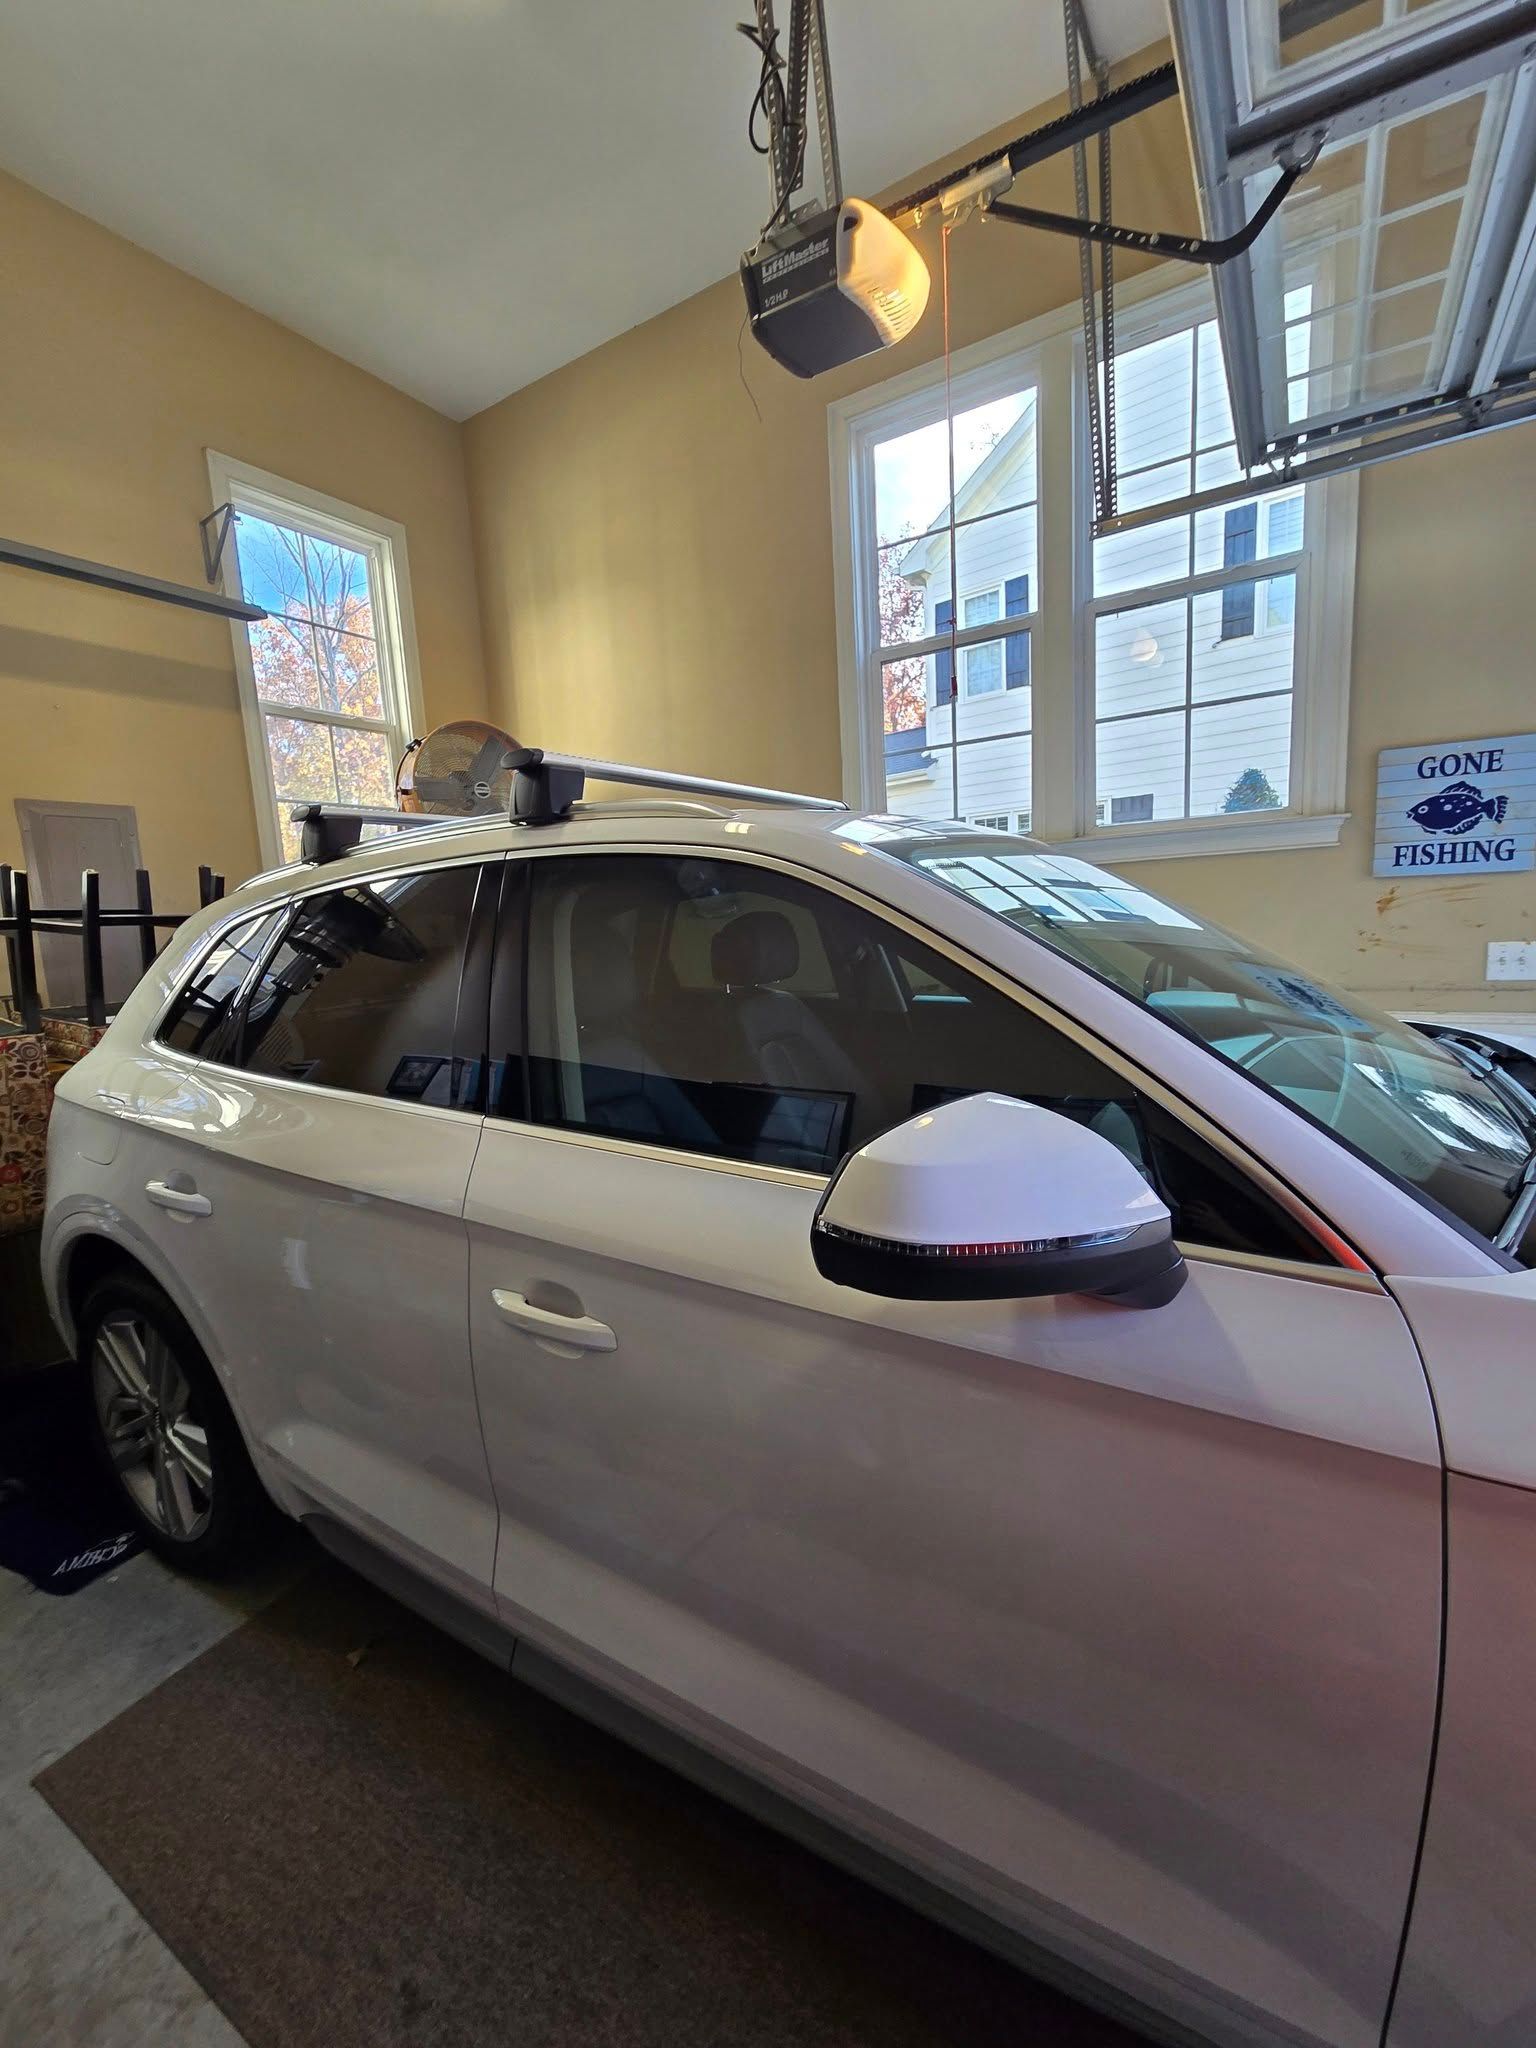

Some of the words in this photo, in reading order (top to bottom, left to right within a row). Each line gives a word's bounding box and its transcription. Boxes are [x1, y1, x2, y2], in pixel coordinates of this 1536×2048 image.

[761, 238, 829, 278] LiftMaster
[1417, 748, 1504, 779] GONE
[1392, 838, 1516, 867] FISHING
